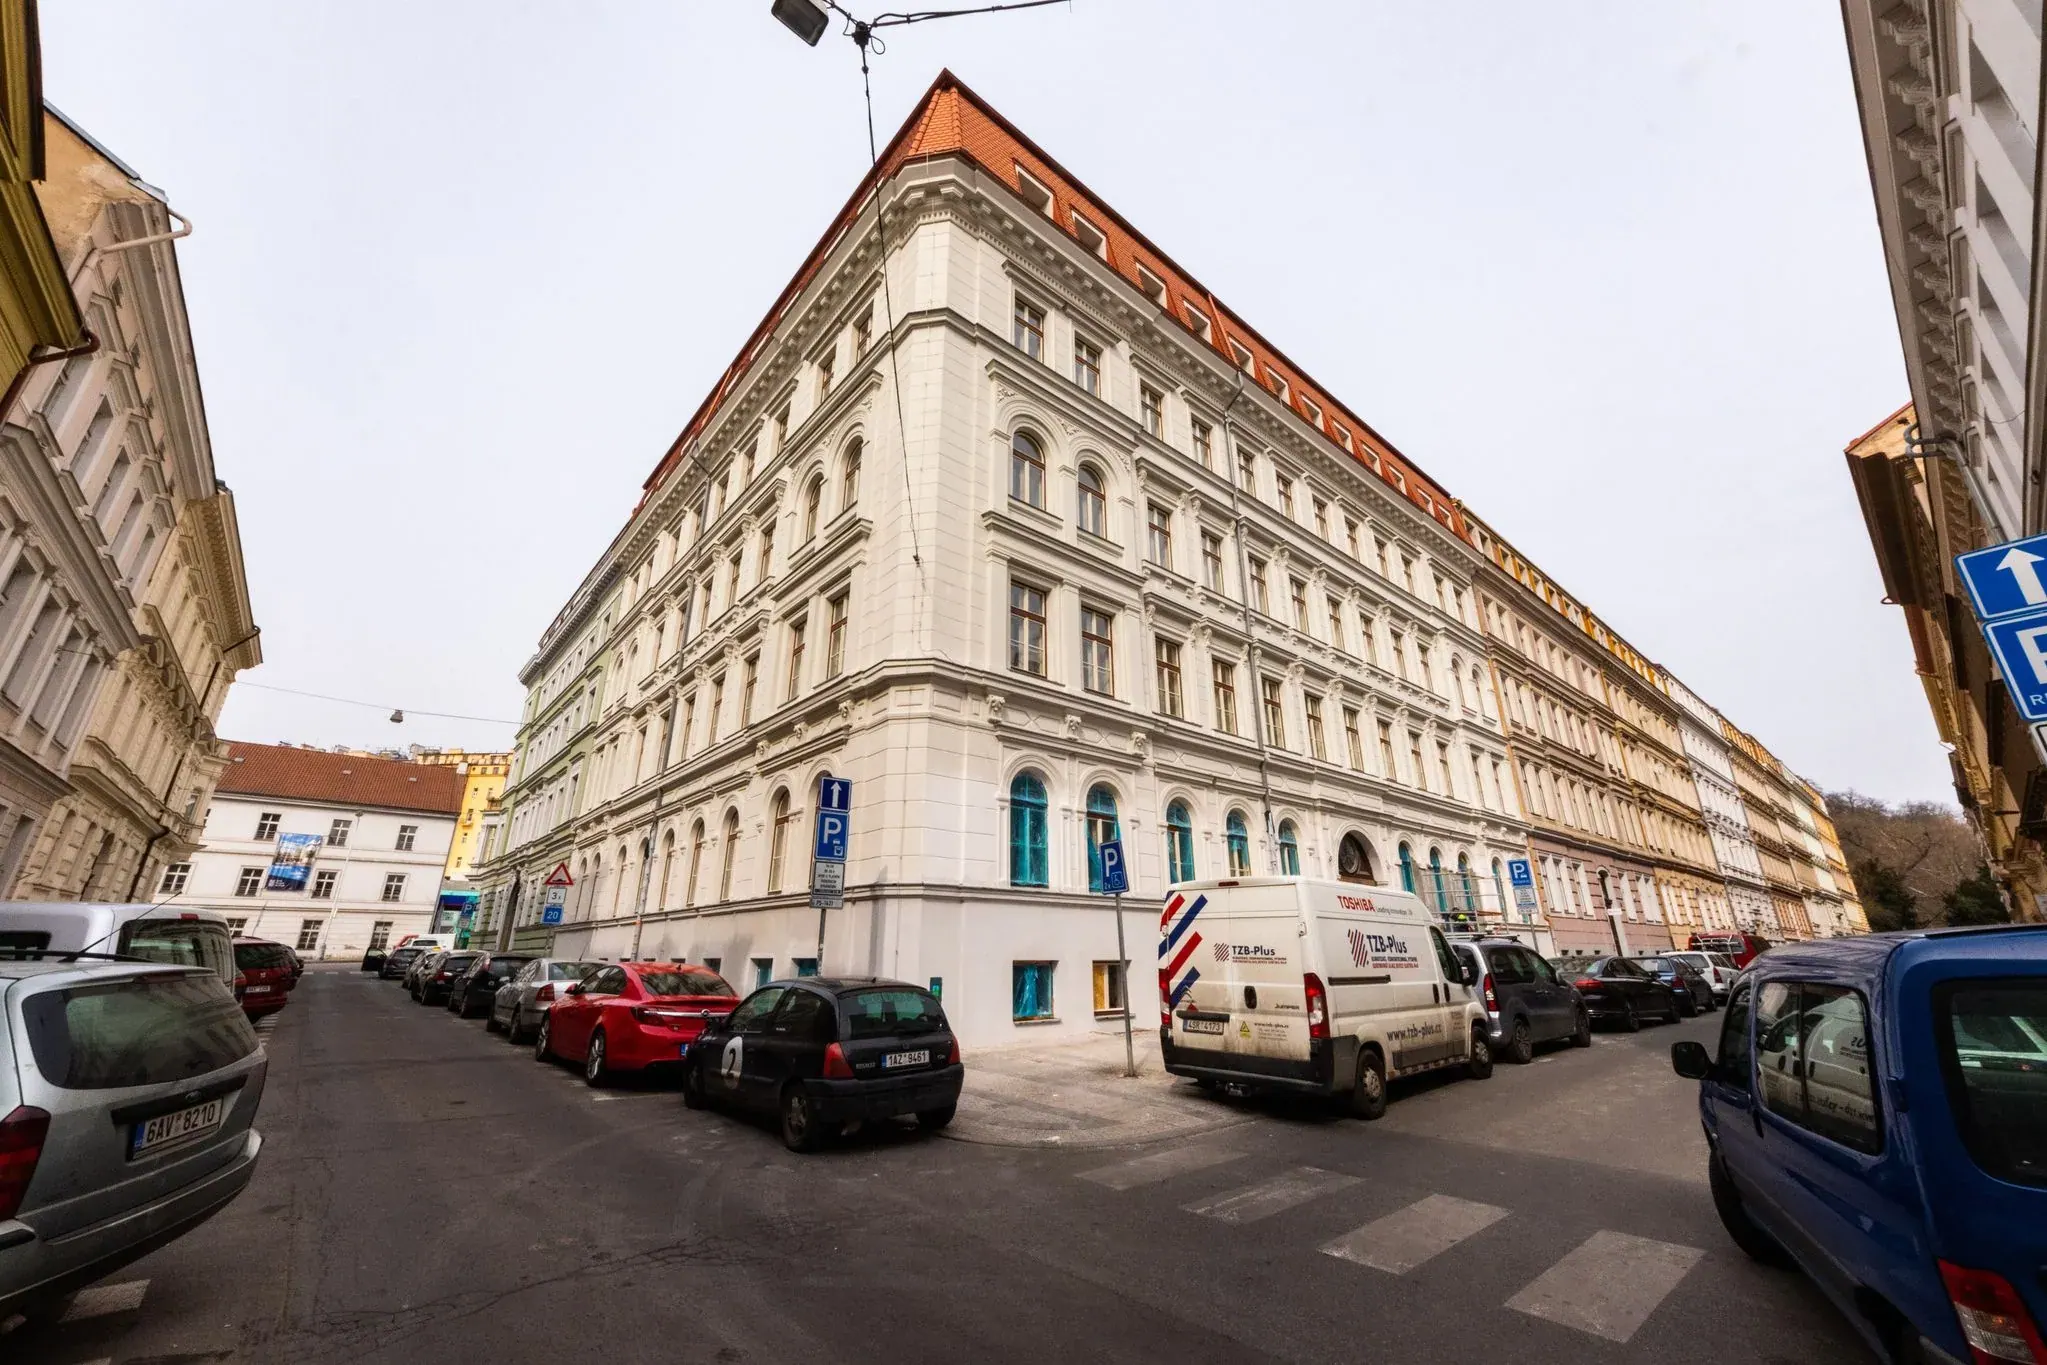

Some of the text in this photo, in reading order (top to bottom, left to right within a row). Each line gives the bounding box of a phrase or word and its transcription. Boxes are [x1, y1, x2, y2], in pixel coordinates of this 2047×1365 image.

[823, 817, 842, 844] P
[1105, 848, 1118, 877] P
[1512, 863, 1525, 878] P
[1337, 896, 1376, 912] TOSHIBA
[1232, 945, 1275, 955] TZB-Plus
[1366, 934, 1407, 953] TZB-Plus
[727, 1048, 736, 1079] 2
[889, 1054, 903, 1066] 1AZ
[908, 1052, 926, 1064] 9461
[147, 1103, 215, 1142] 6AV 8210
